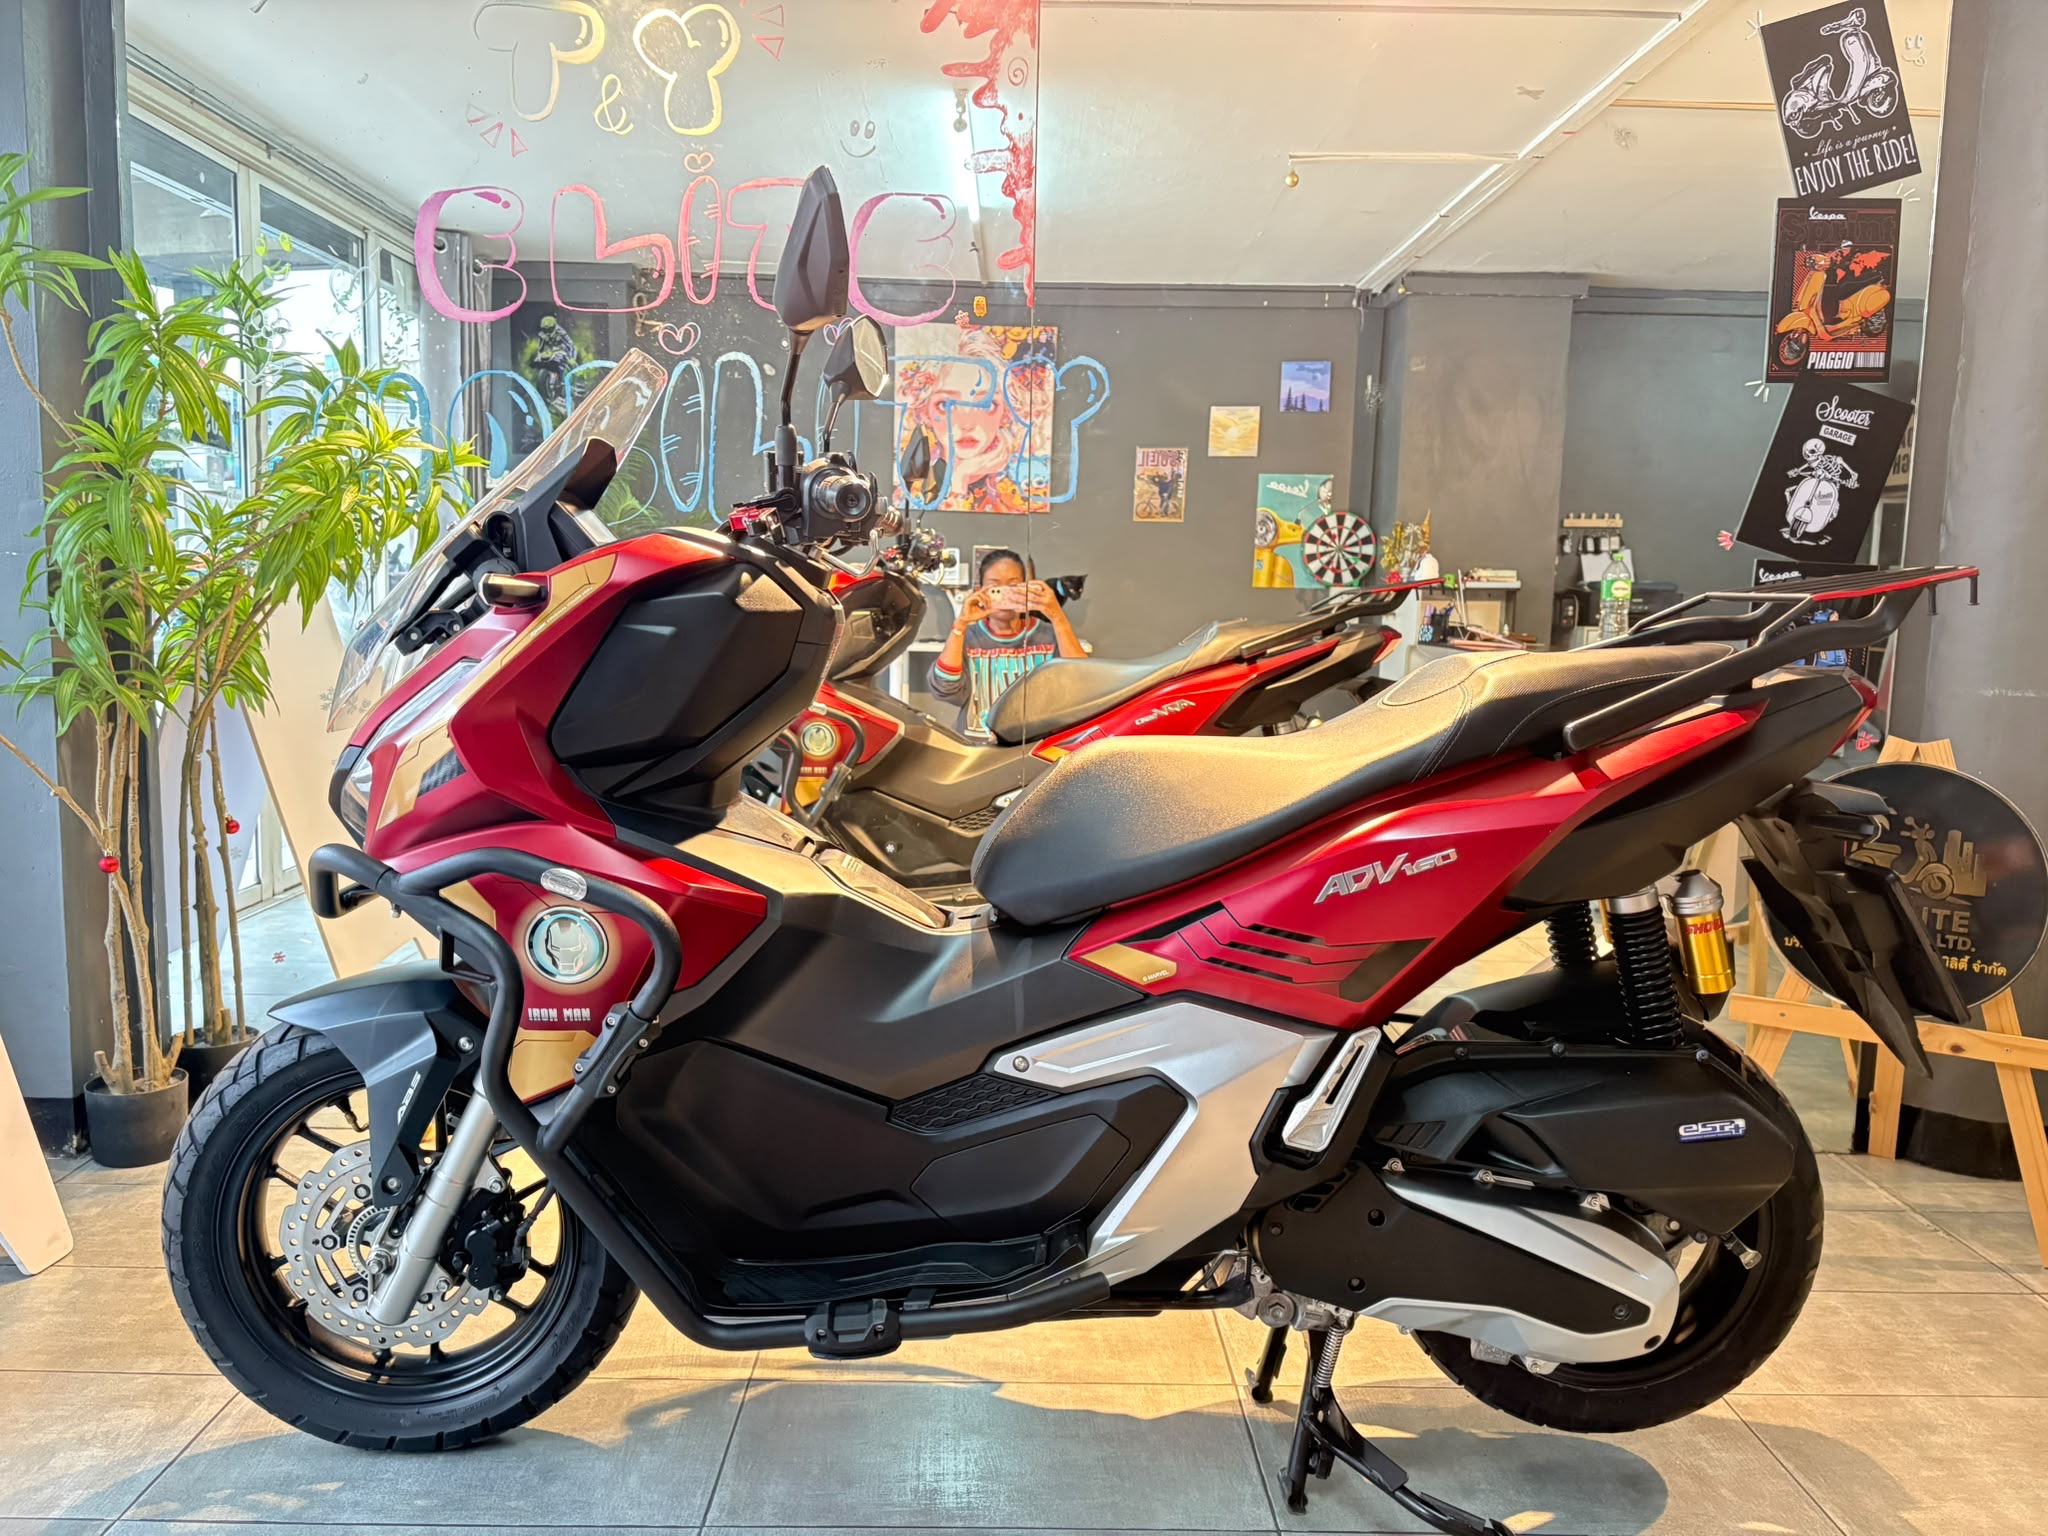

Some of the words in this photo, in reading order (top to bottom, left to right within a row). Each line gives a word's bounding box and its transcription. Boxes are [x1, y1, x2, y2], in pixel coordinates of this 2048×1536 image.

[593, 73, 635, 136] &
[1811, 139, 1834, 158] Life
[1835, 140, 1844, 150] is
[1852, 128, 1890, 149] journey
[1794, 155, 1844, 197] ENJOY
[1843, 147, 1874, 181] THE
[1872, 133, 1917, 174] RIDE!
[1808, 205, 1847, 221] Vespa
[1806, 351, 1855, 370] PIAGGIO
[1815, 394, 1875, 427] Scooter
[1823, 427, 1853, 443] GARAGE
[1759, 567, 1802, 583] Vespa
[1936, 933, 1976, 953] LTD.
[527, 1007, 558, 1022] IRON
[563, 1007, 591, 1022] MAN
